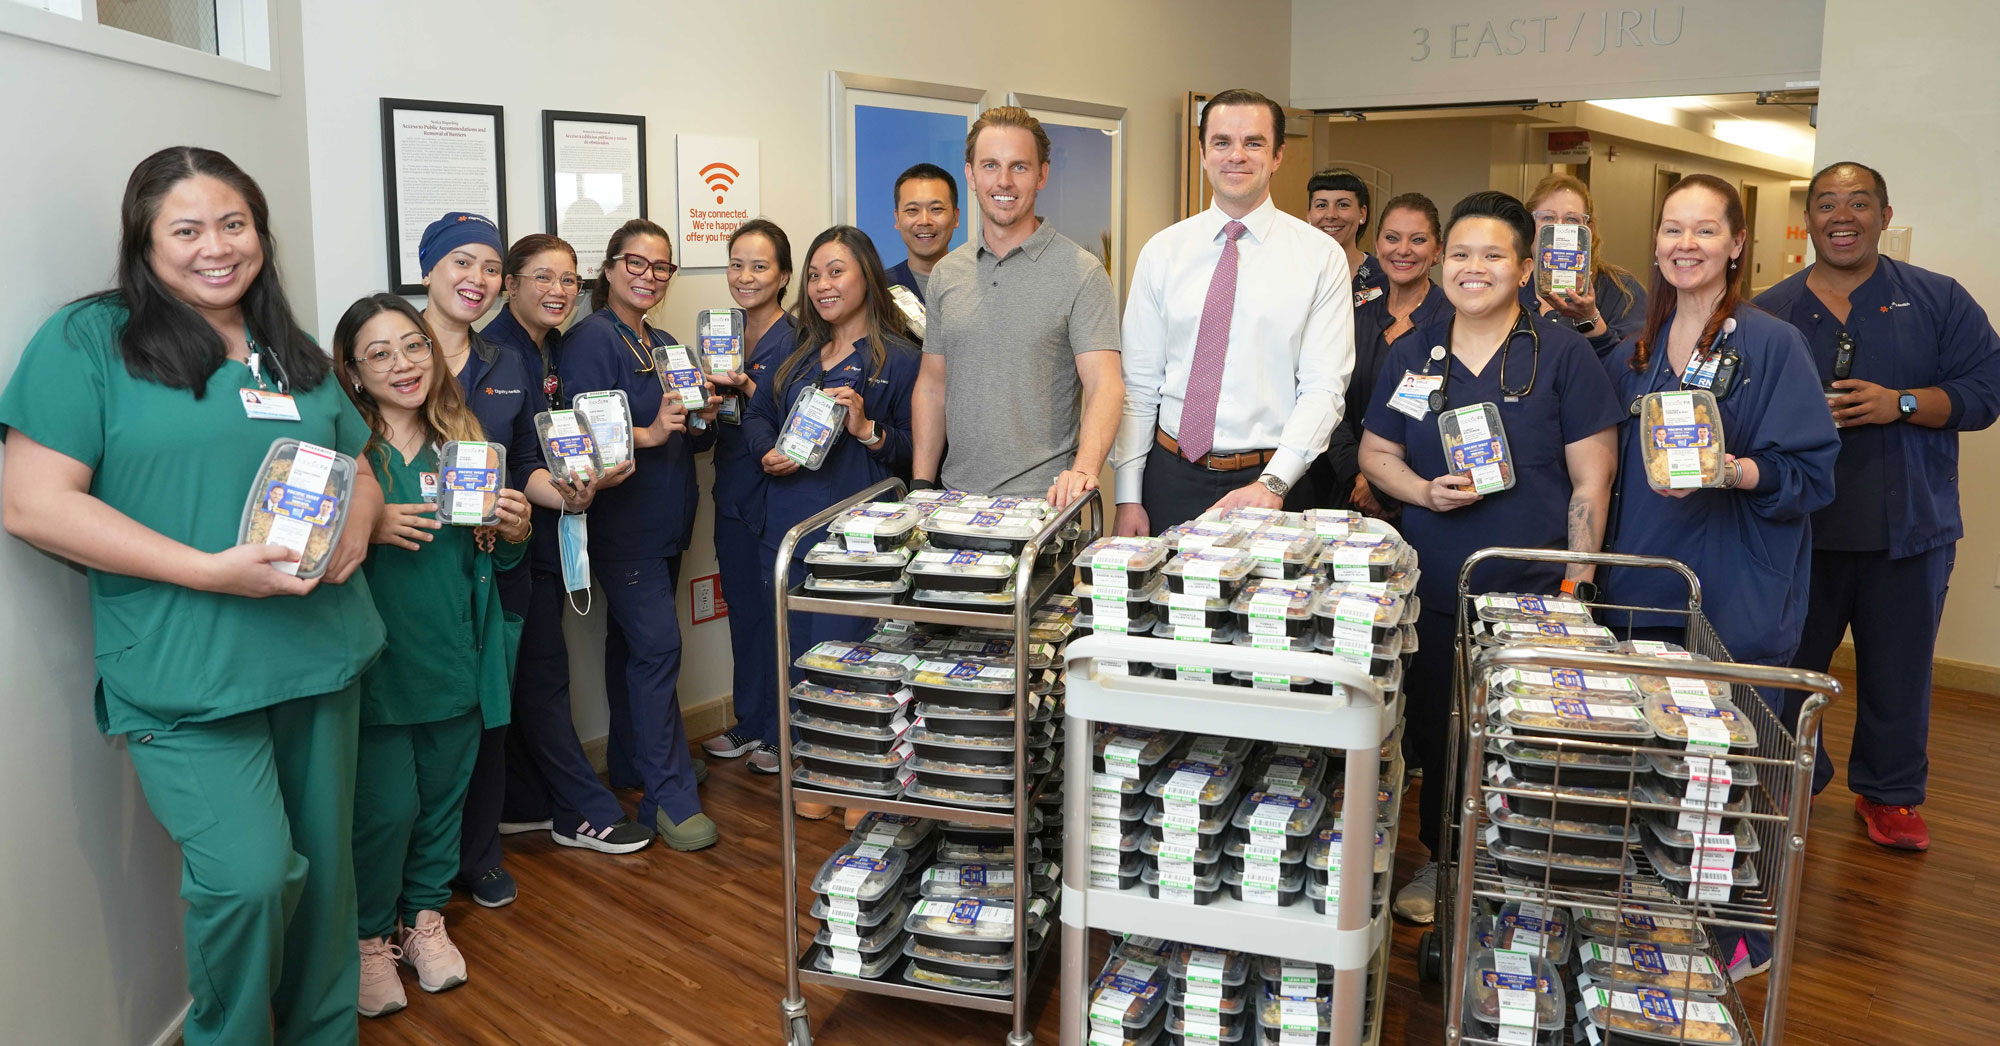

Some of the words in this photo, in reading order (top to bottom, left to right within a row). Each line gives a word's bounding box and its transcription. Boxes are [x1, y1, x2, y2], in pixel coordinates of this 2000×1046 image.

[1410, 28, 1430, 62] 3
[1450, 16, 1557, 59] EAST
[1593, 6, 1685, 56] JRU
[689, 208, 707, 220] Stay
[707, 209, 749, 219] connected.
[692, 220, 714, 230] We're
[715, 220, 737, 231] happy
[686, 231, 704, 242] offer
[705, 234, 718, 243] you
[1698, 377, 1713, 387] RN
